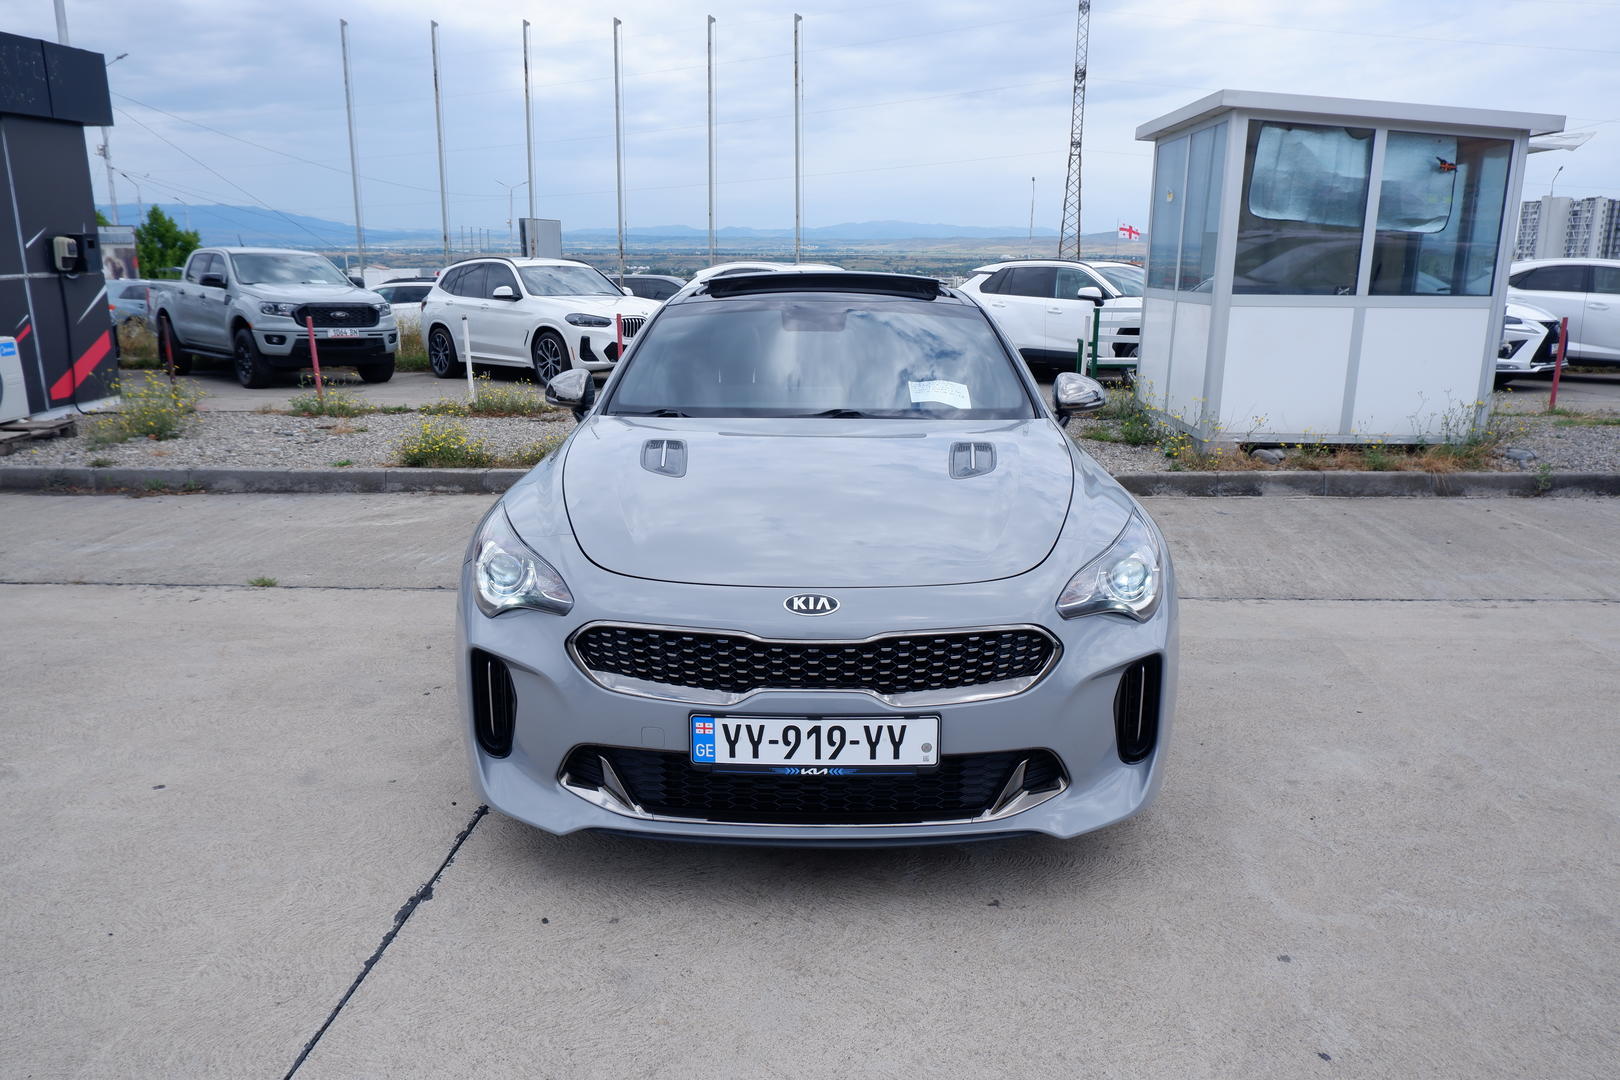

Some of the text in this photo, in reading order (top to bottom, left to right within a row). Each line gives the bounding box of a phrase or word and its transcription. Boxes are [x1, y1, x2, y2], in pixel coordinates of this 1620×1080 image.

[793, 597, 831, 610] KIA
[722, 723, 907, 760] YY-919-YY
[696, 744, 714, 757] GE
